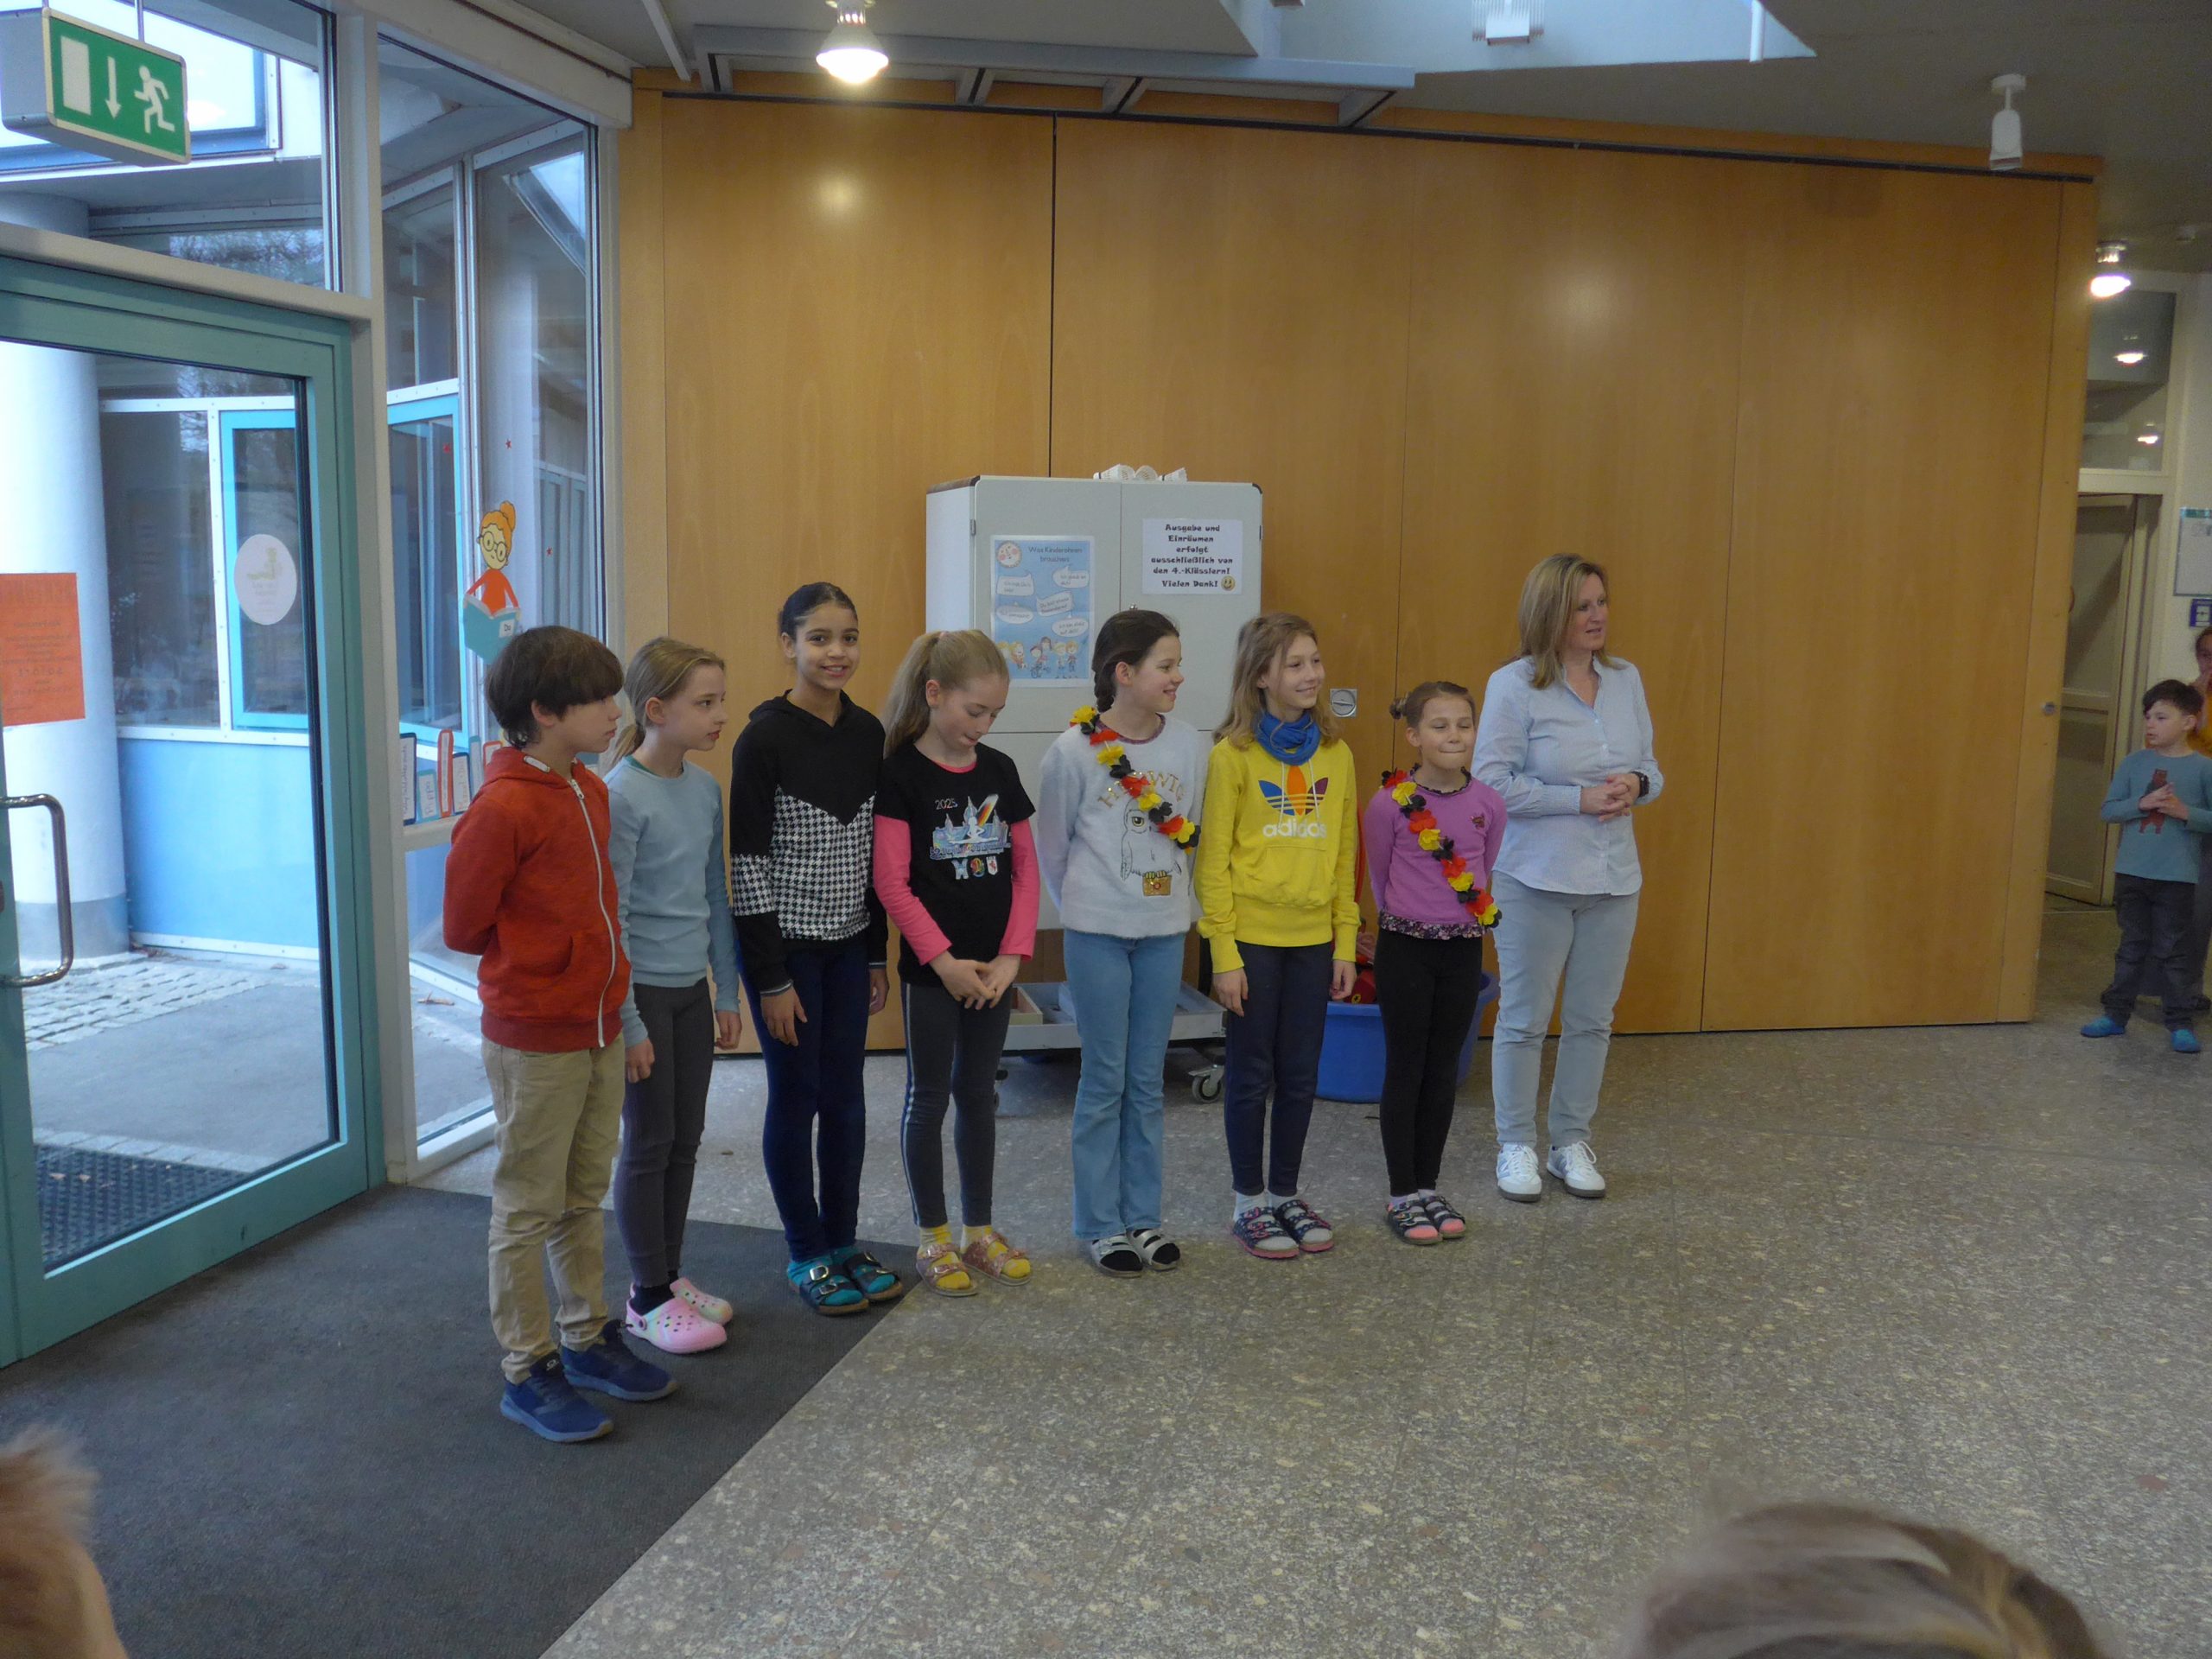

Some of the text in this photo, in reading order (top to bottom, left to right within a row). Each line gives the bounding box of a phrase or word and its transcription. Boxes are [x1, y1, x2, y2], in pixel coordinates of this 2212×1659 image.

[1165, 524, 1202, 532] Ausgabe
[1176, 546, 1208, 555] erfolgt
[1097, 770, 1185, 808] HWIG
[934, 798, 958, 810] 2025
[1262, 817, 1327, 838] adidas
